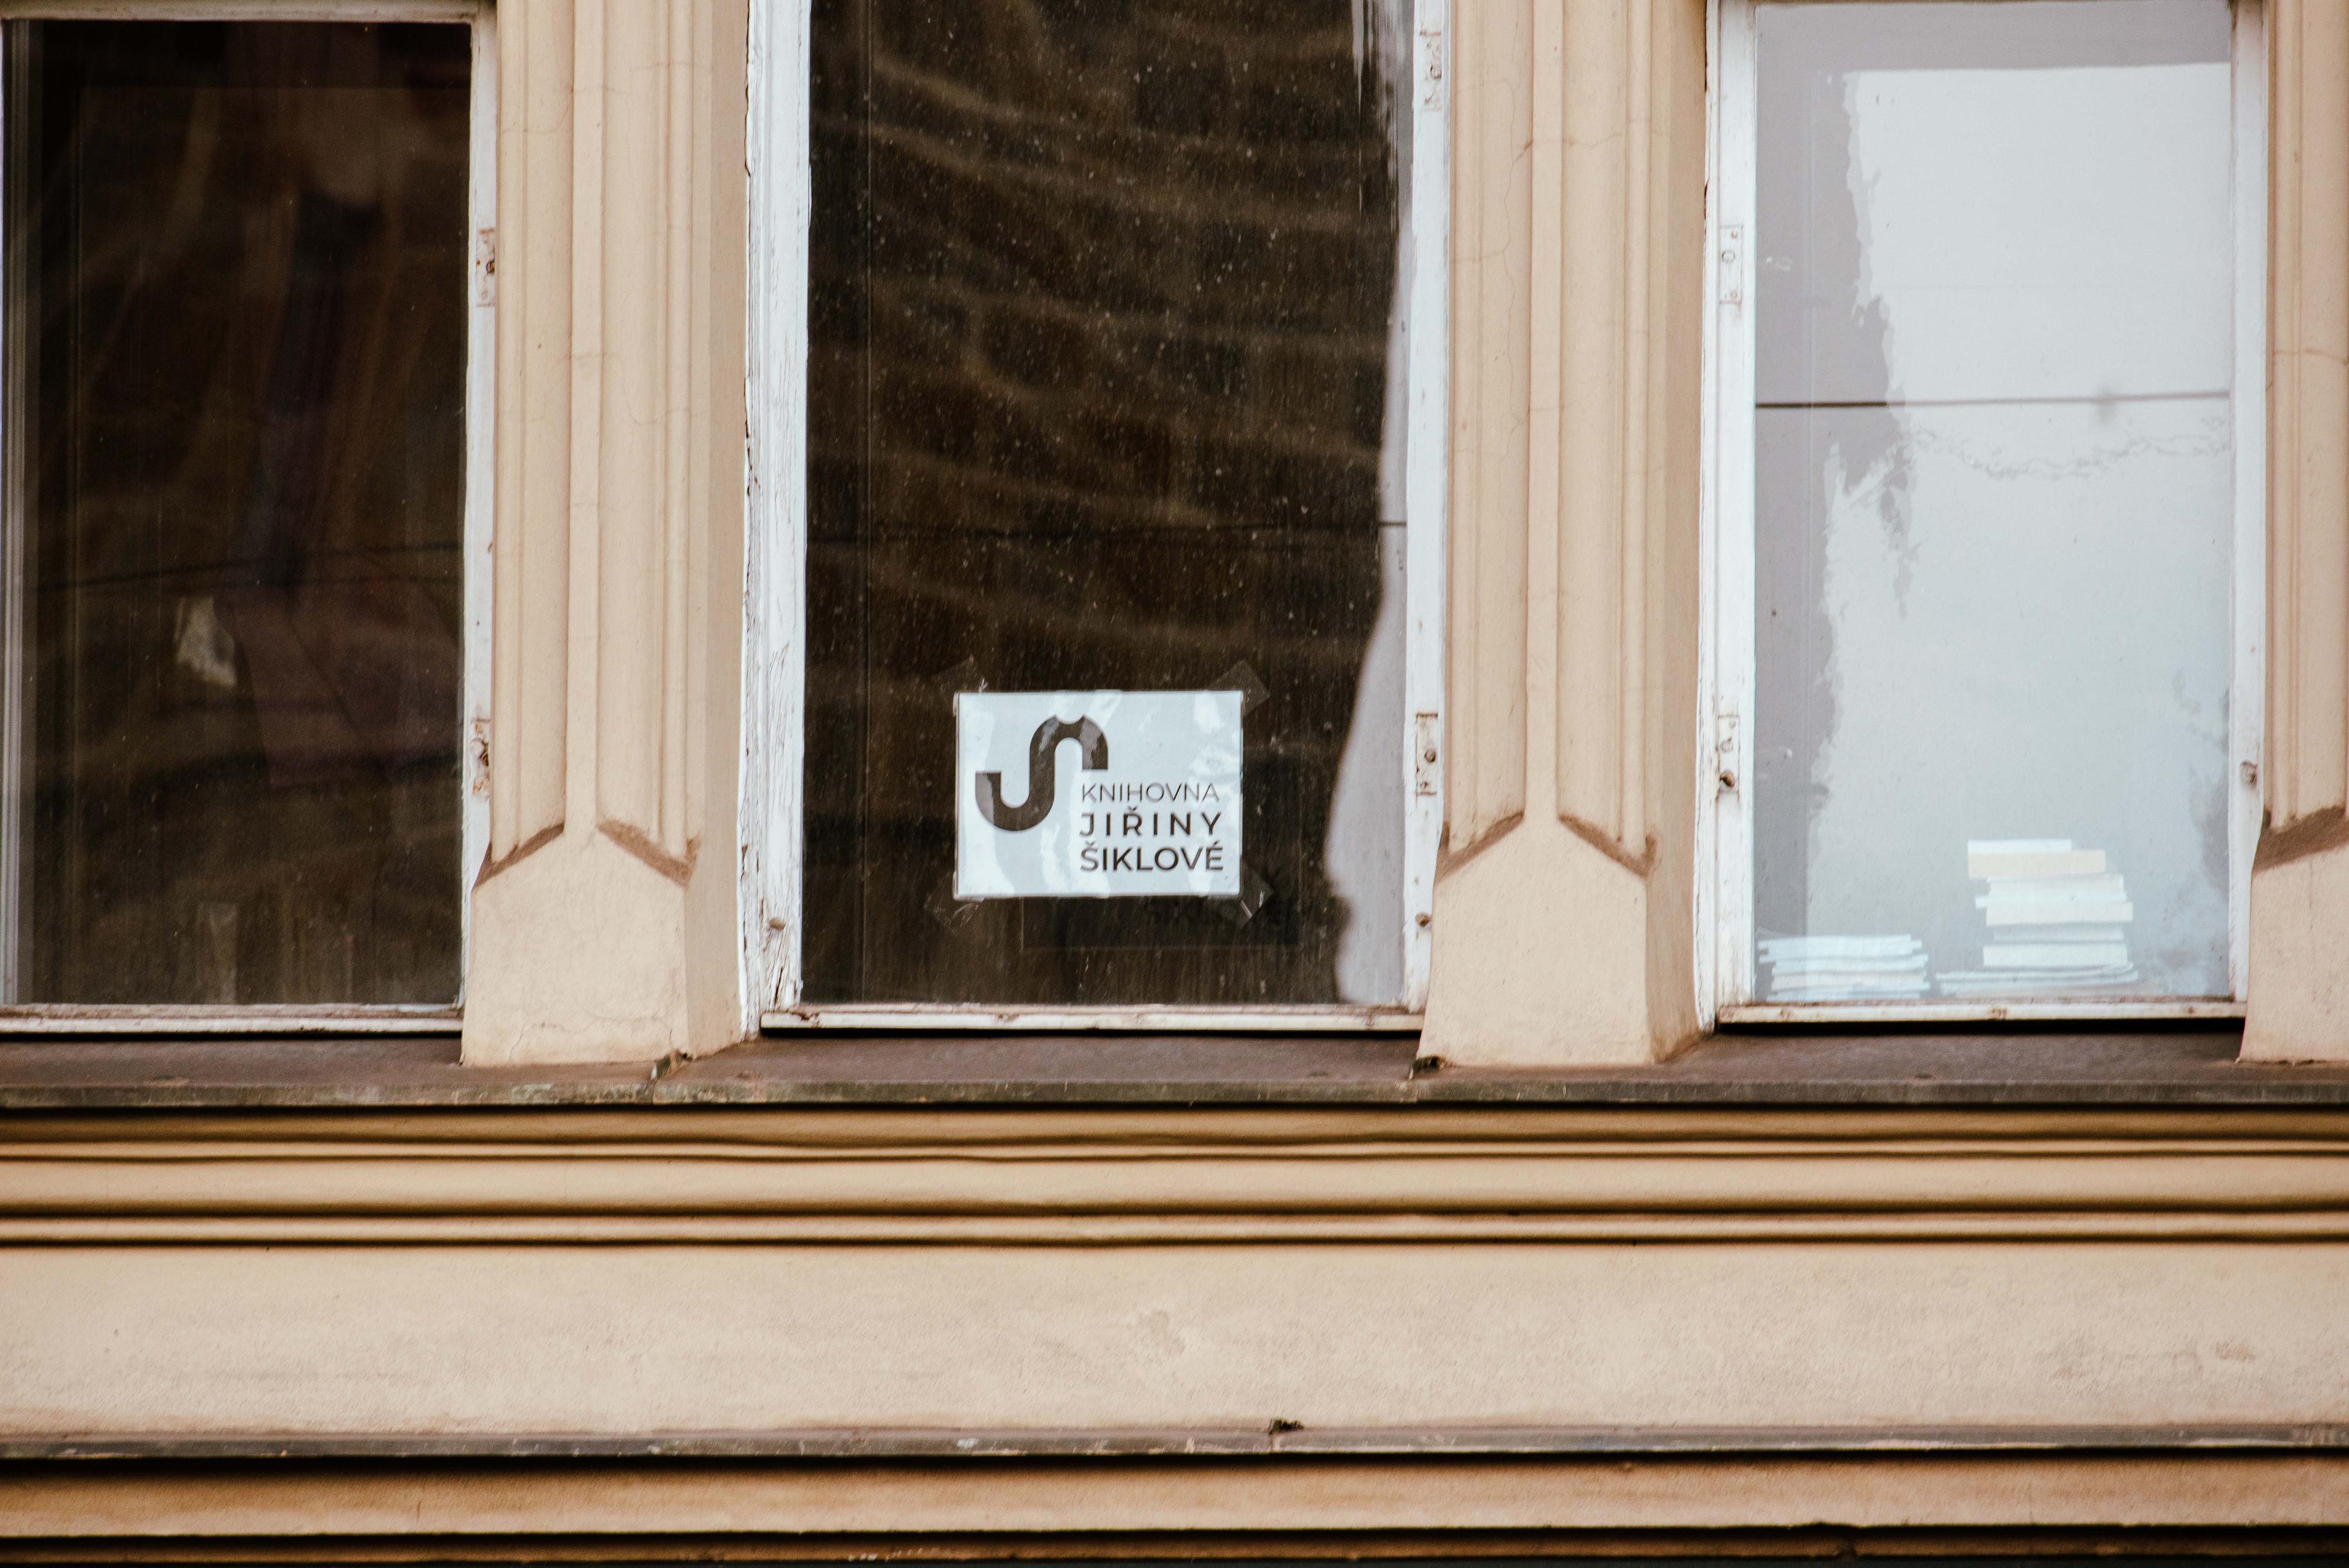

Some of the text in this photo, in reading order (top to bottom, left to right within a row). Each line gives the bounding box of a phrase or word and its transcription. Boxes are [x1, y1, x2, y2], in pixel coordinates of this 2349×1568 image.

[1082, 783, 1220, 802] KNIHOVNA
[1079, 806, 1221, 837] JIŘINY
[1080, 840, 1224, 872] ŠIKLOVÉ
